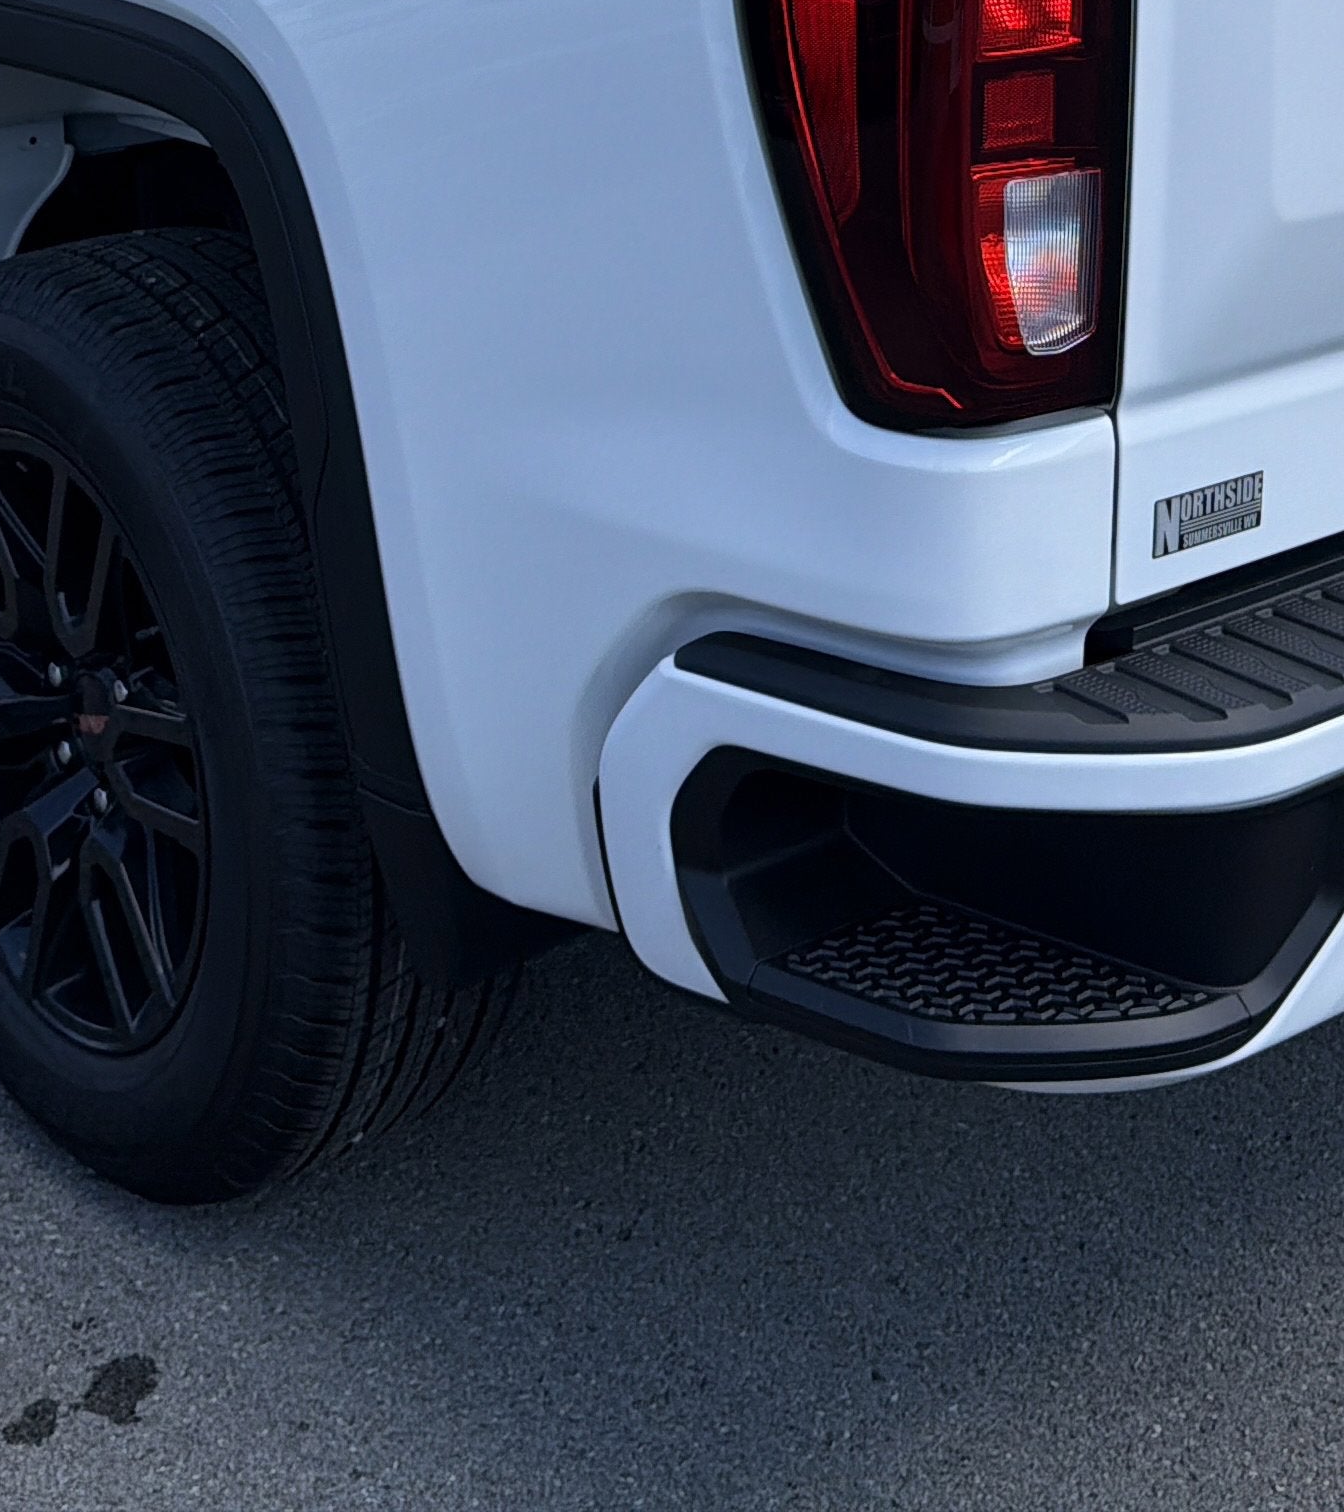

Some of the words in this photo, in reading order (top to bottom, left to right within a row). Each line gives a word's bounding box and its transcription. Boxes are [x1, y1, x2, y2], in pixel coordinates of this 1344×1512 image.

[1154, 473, 1262, 557] NORTHSIDE
[1182, 517, 1243, 549] SUMMERSVILLE
[1243, 512, 1258, 529] WV
